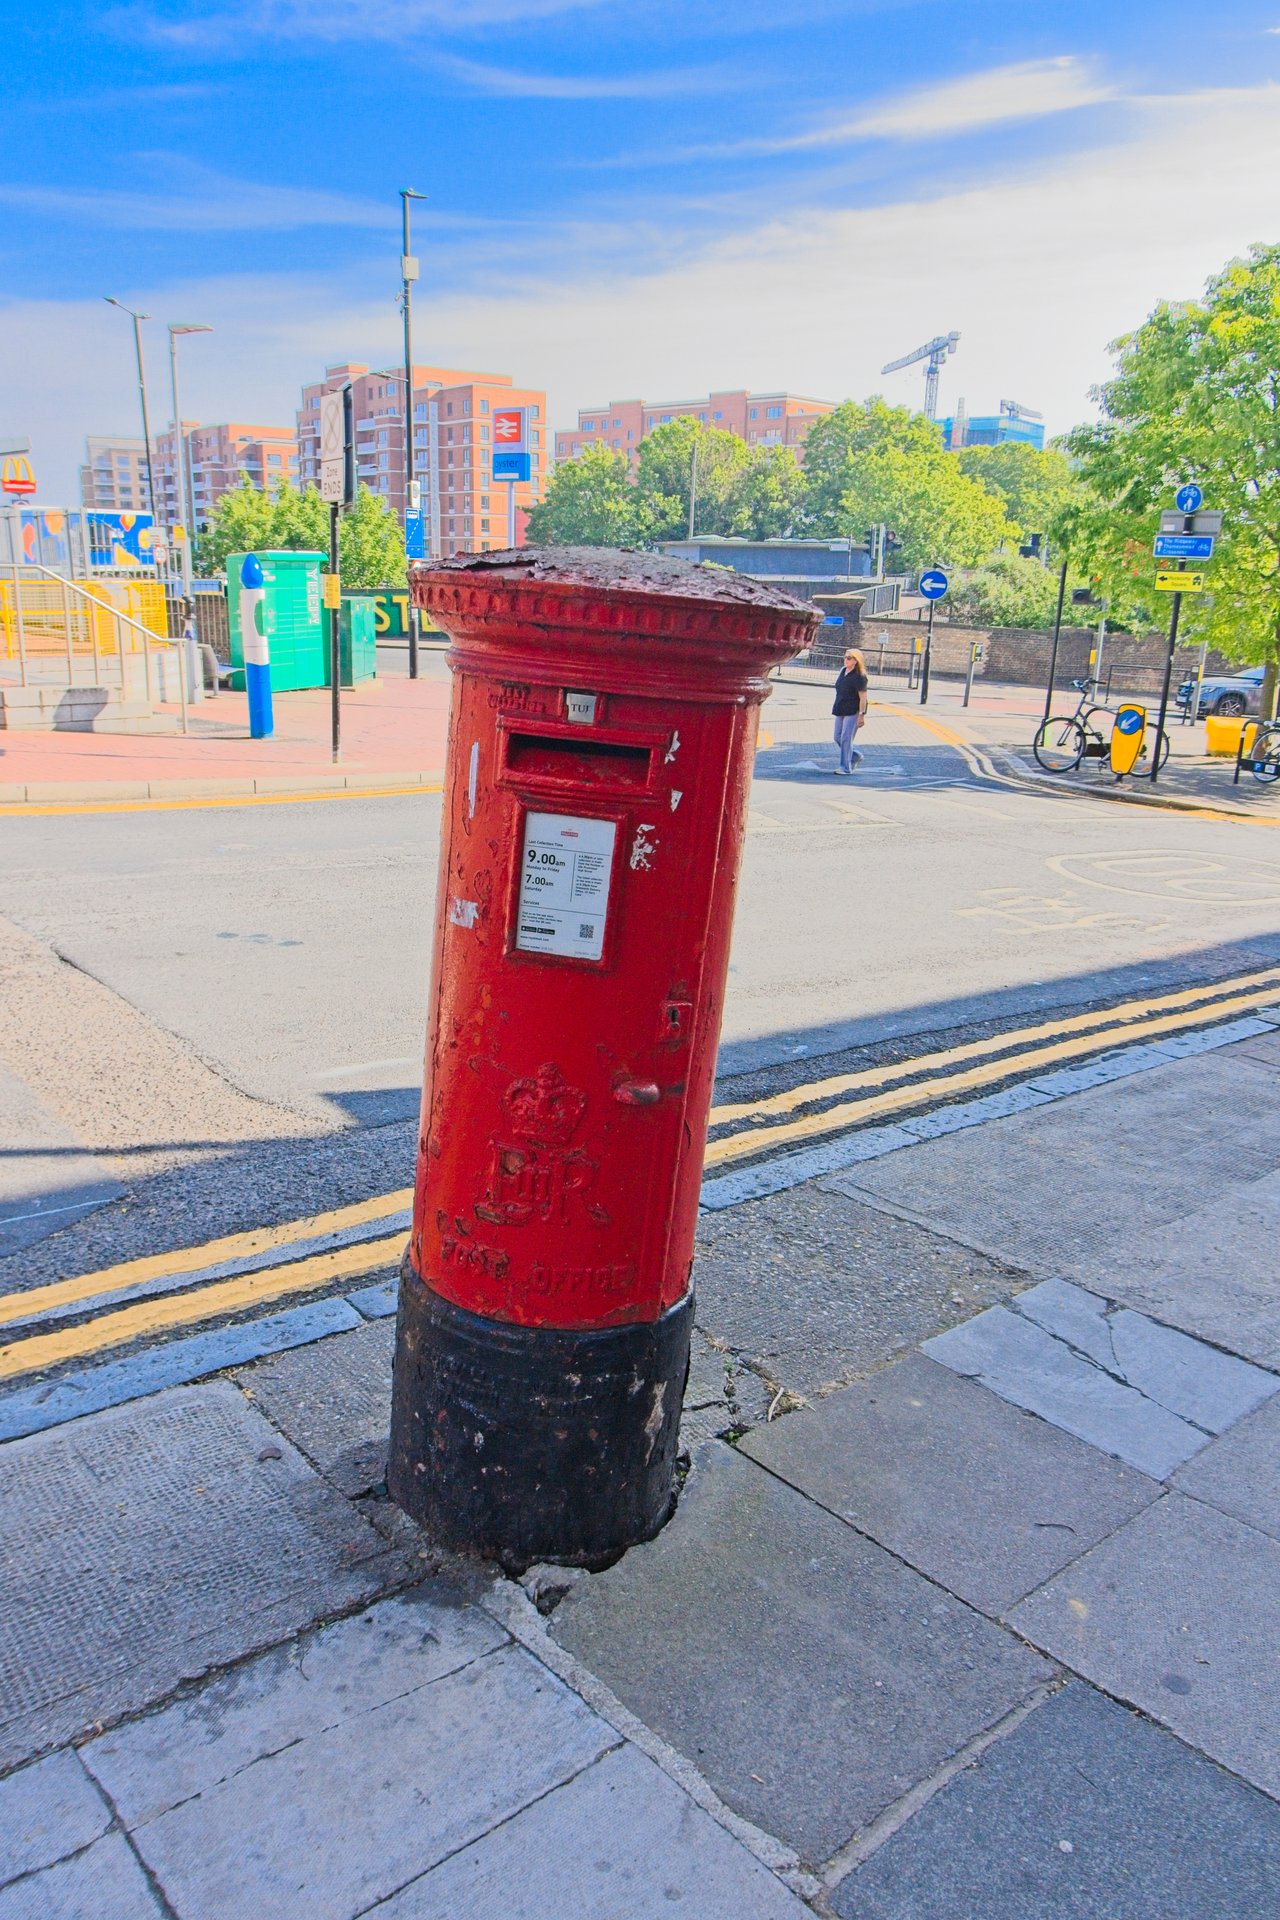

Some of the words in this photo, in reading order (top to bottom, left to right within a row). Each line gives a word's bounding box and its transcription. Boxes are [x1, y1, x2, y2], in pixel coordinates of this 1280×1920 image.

[324, 480, 341, 495] ENDS
[528, 849, 566, 866] 9.00am
[526, 874, 554, 886] 7.00am
